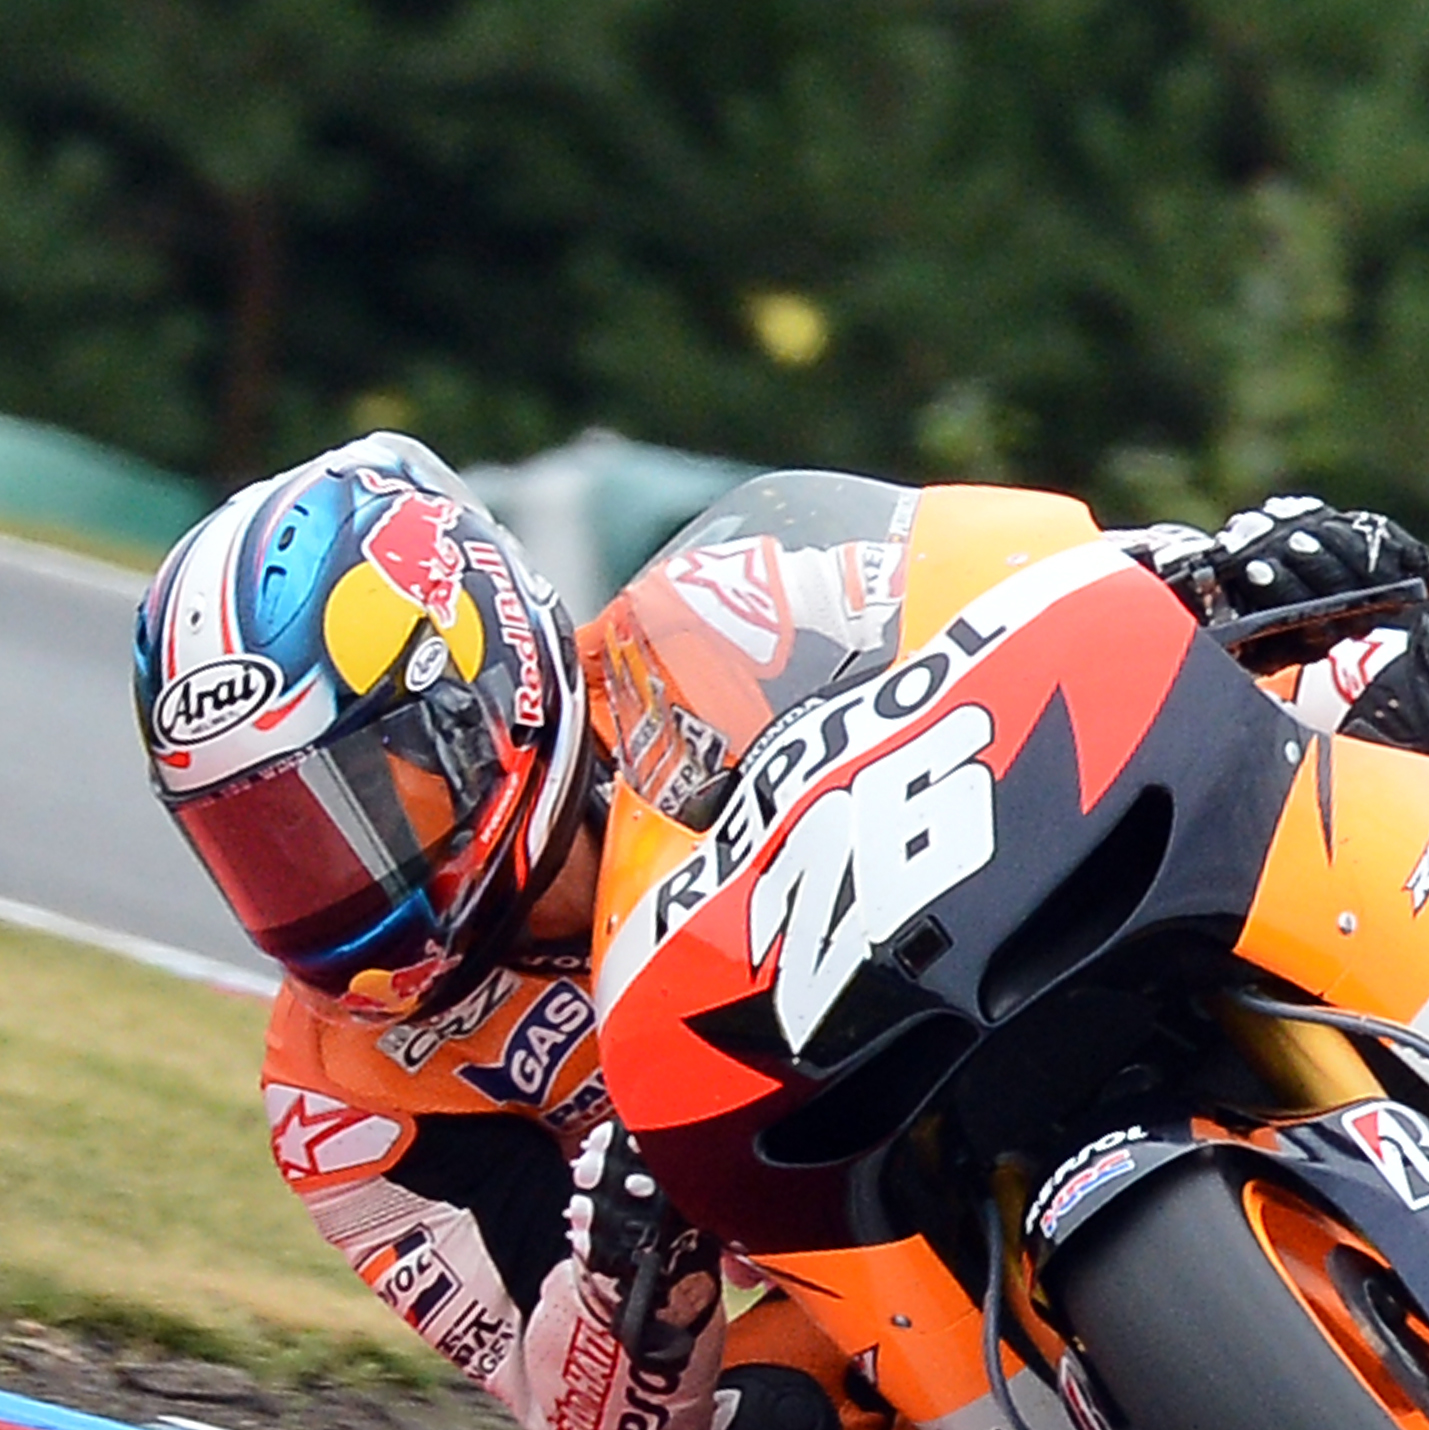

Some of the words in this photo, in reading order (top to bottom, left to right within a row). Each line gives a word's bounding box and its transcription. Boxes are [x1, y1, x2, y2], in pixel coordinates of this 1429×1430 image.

[165, 662, 256, 737] Arai
[655, 617, 1006, 945] REPSOL
[748, 702, 994, 1056] 26
[510, 992, 589, 1094] GAS
